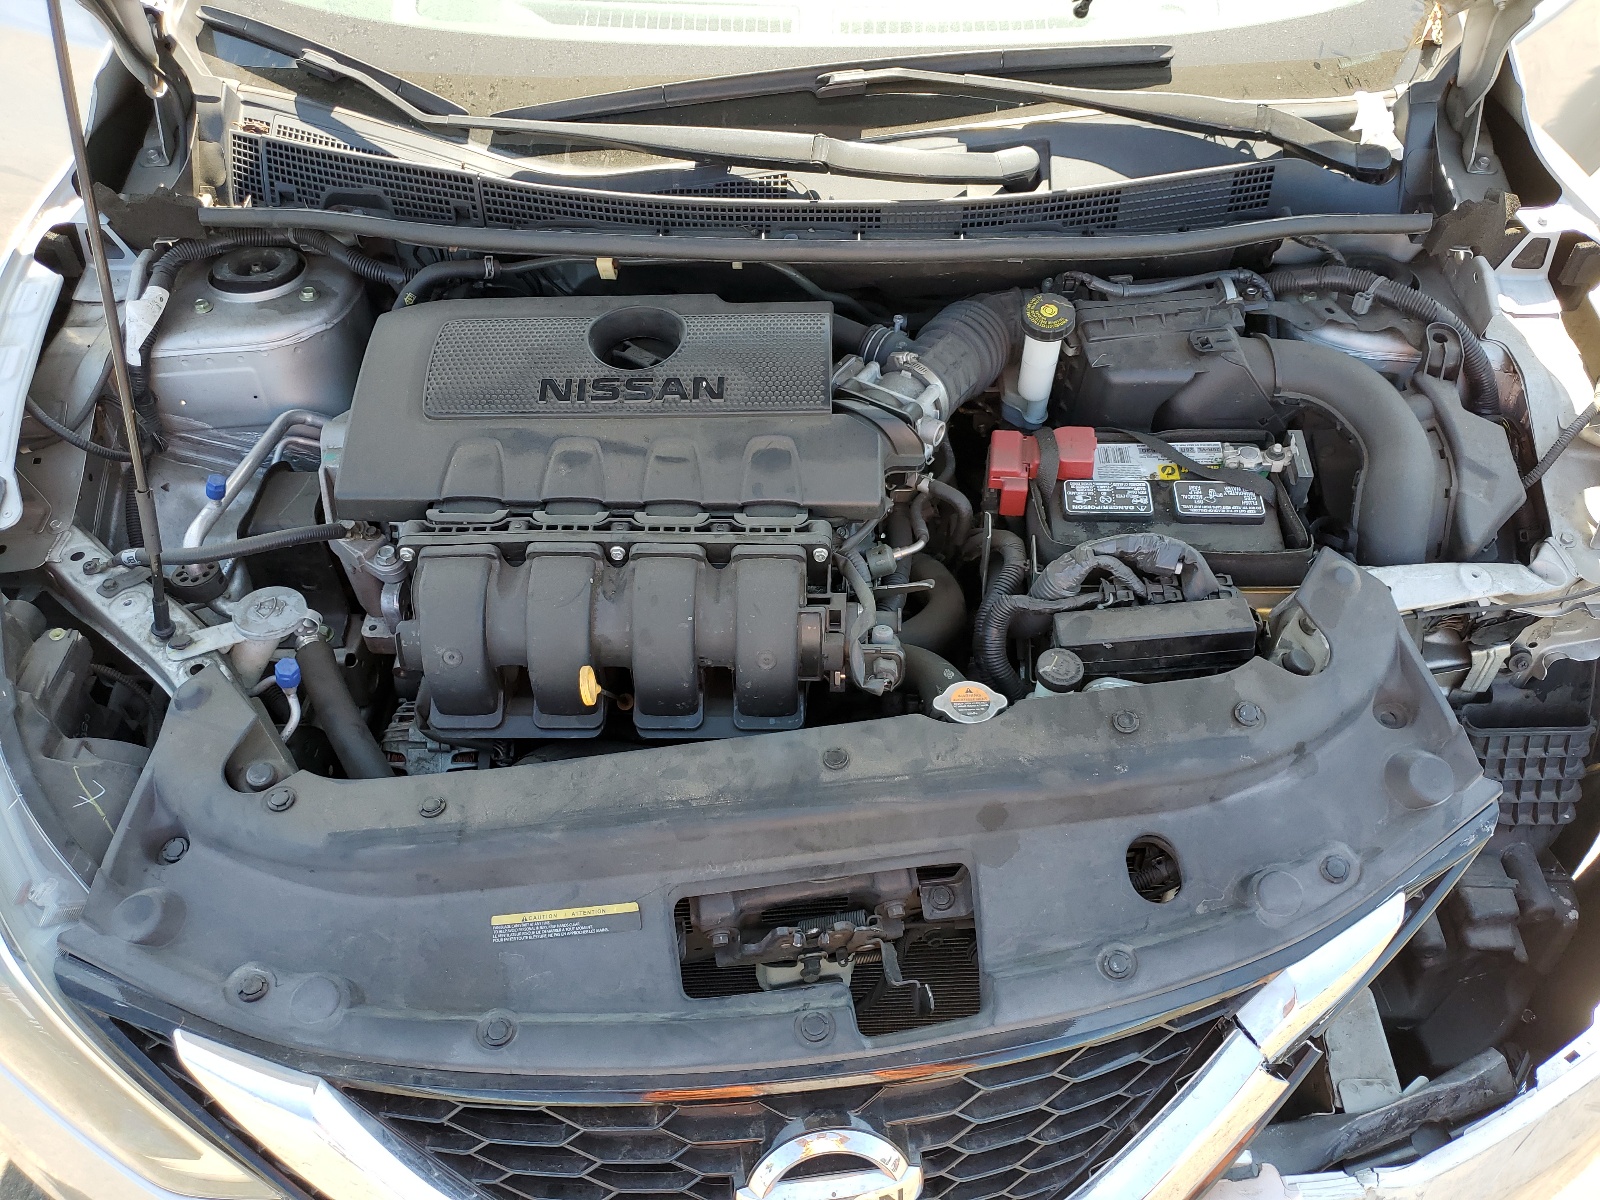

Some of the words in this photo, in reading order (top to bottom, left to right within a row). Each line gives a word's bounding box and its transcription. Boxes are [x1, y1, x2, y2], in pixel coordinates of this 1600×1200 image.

[538, 376, 725, 403] NISSAN
[528, 913, 558, 921] CAUTION
[571, 909, 606, 917] ATTENTION
